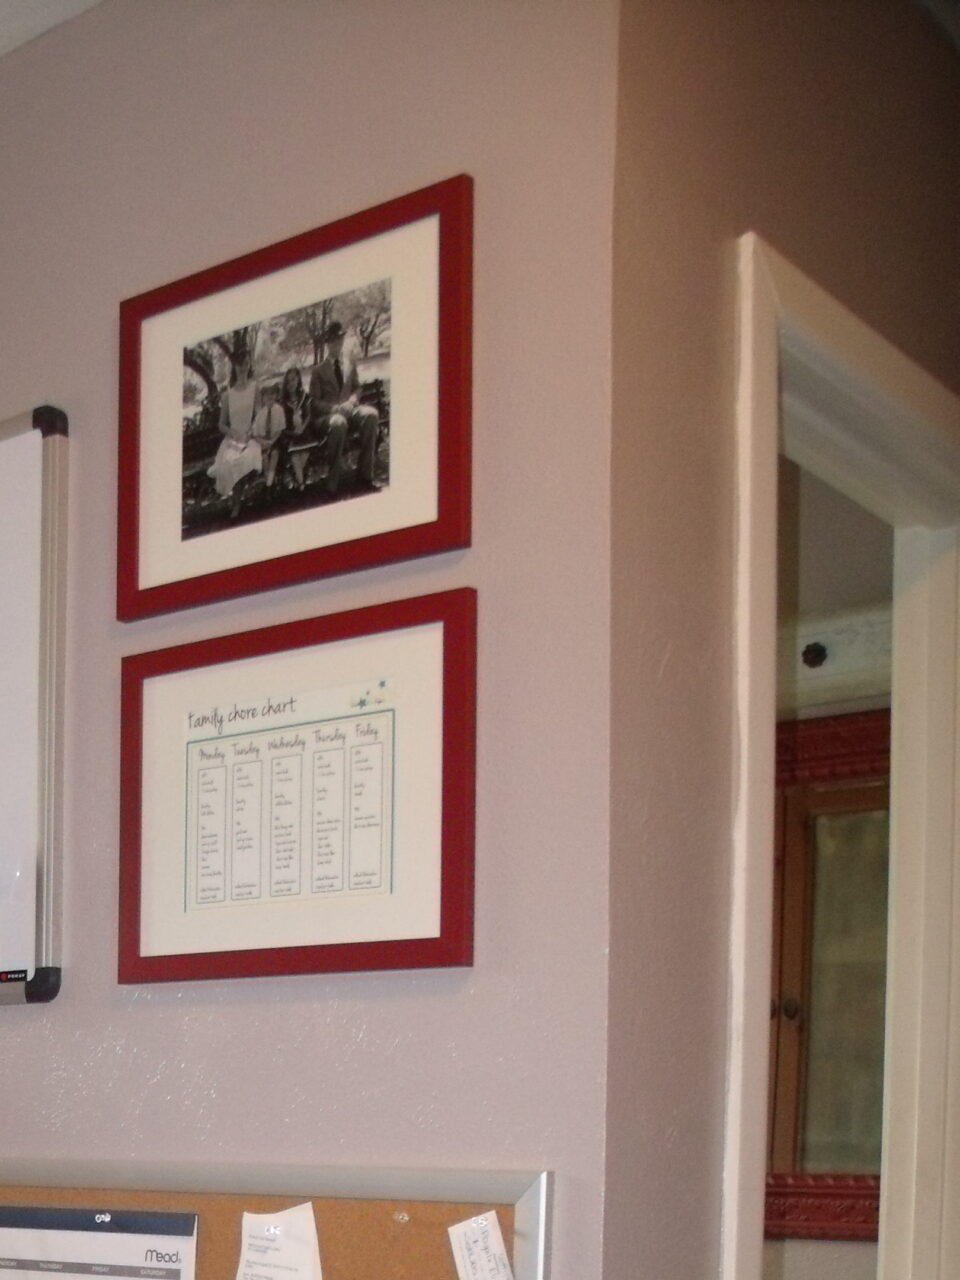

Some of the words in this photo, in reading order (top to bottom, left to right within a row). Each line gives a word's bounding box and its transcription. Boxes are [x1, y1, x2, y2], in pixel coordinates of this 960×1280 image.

[188, 707, 224, 735] Family
[227, 704, 258, 722] chore
[261, 697, 296, 717] chart
[356, 723, 379, 741] Friday
